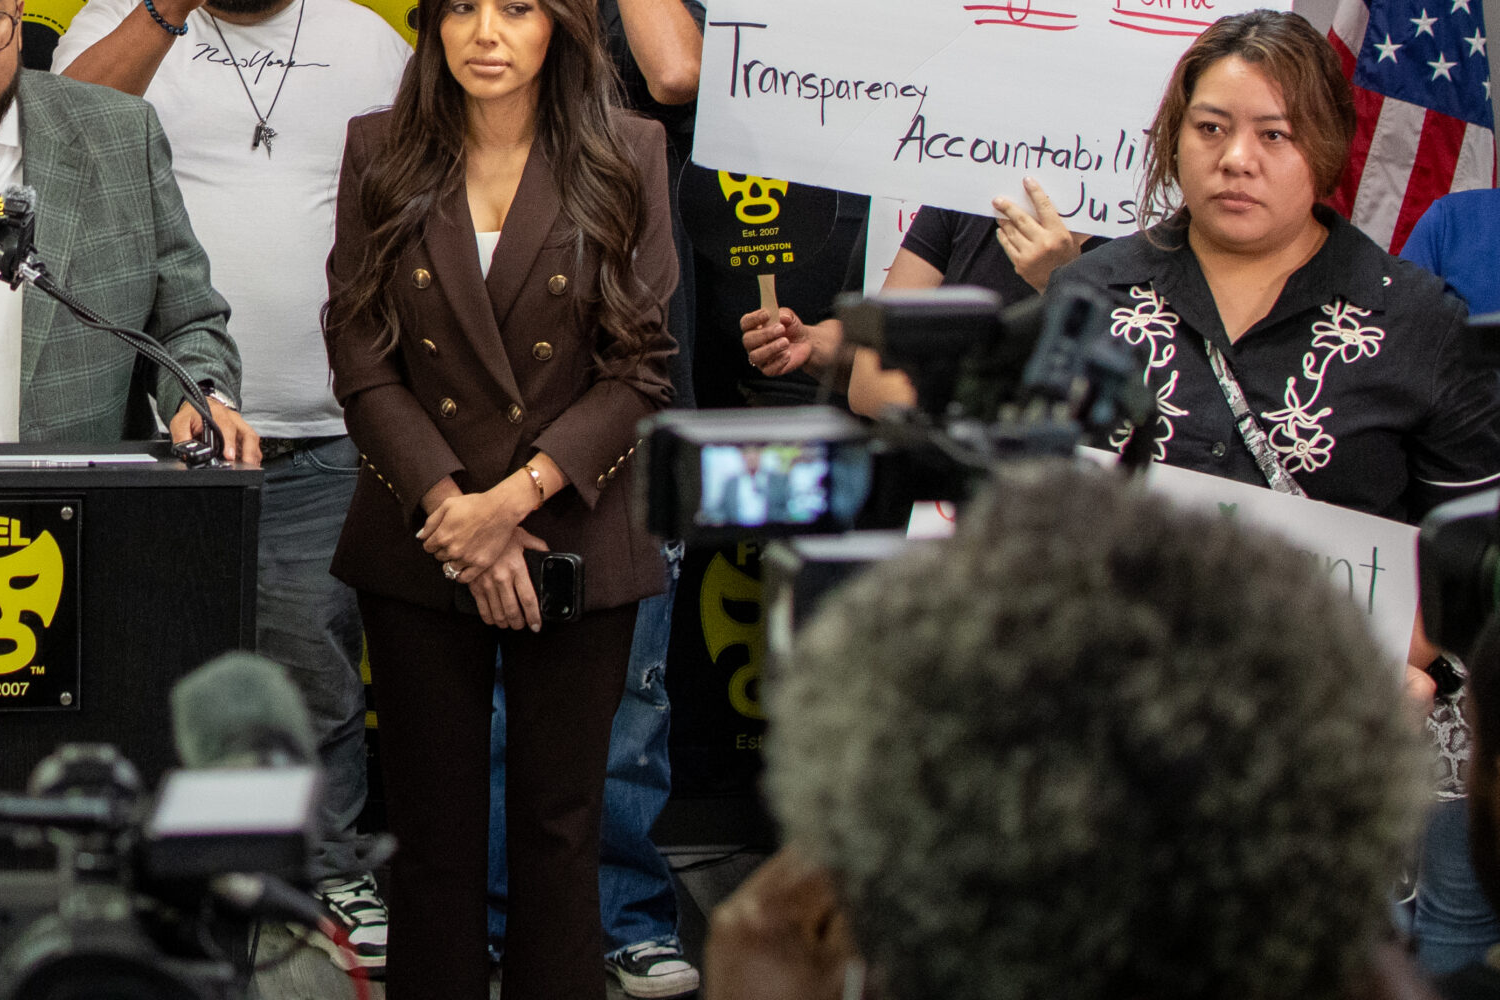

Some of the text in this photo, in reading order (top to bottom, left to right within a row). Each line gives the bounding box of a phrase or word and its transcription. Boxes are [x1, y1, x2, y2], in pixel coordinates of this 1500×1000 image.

[709, 21, 928, 127] Transparency
[741, 227, 780, 238] Est. 2007
[729, 242, 791, 255] @FIELHOUSTON
[30, 666, 45, 675] TM
